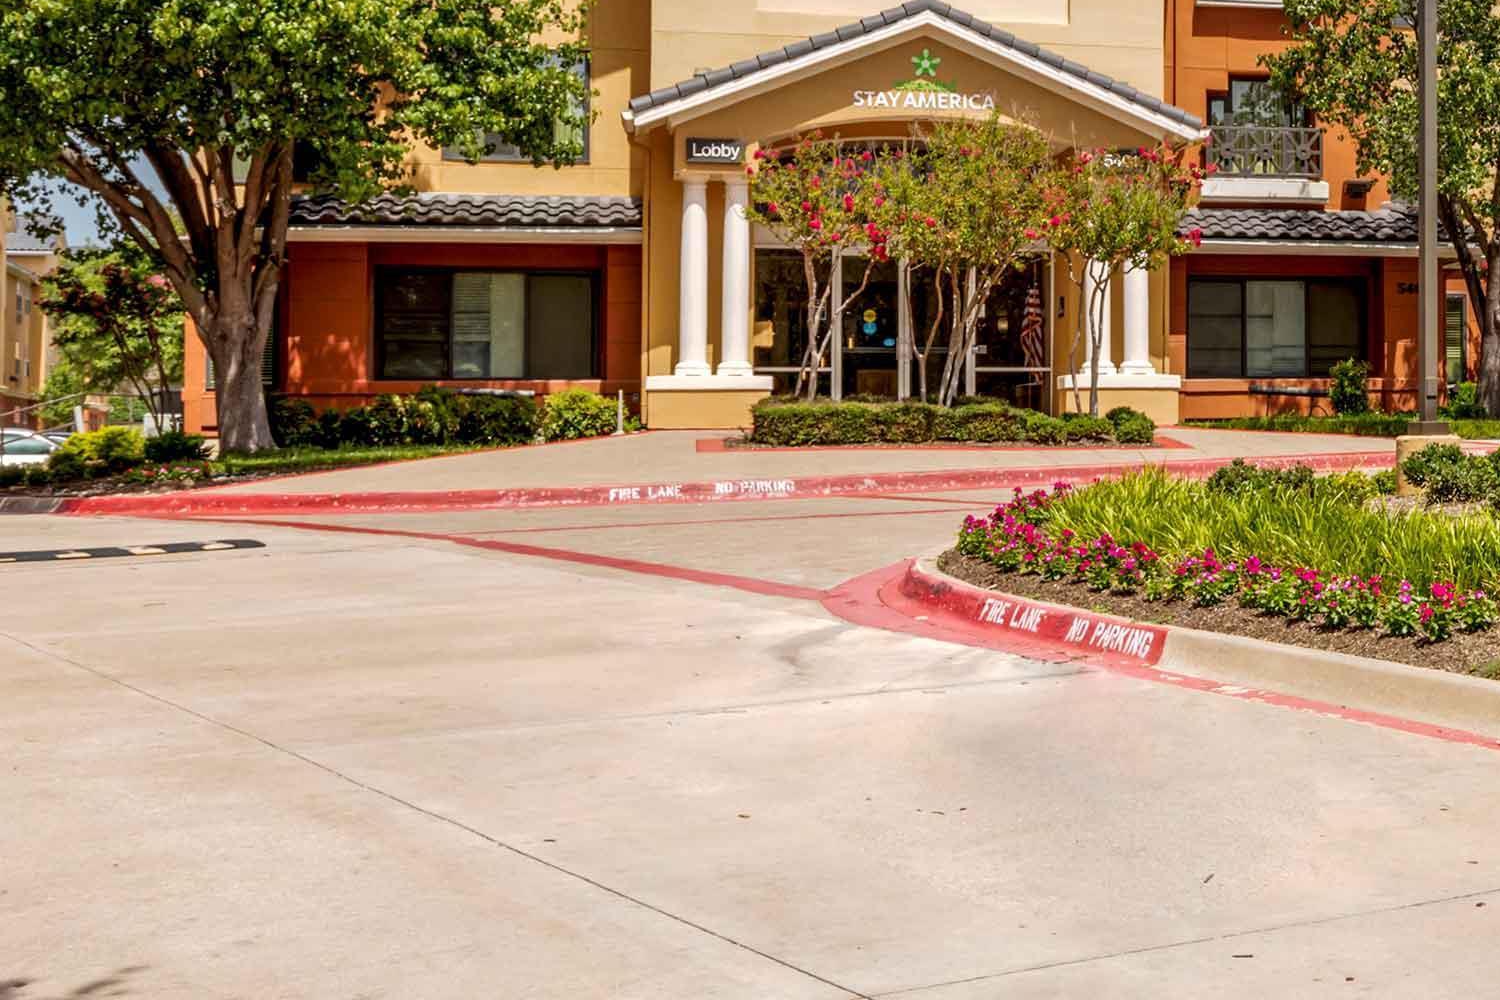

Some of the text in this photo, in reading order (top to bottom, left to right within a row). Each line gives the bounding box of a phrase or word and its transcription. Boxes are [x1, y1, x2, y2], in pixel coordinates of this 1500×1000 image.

[853, 90, 995, 110] STAY AMERICA
[692, 142, 740, 161] Lobby
[609, 479, 796, 501] FIRE LANE NO PARKING
[979, 599, 1154, 658] FIRE LANE NO PARKING
